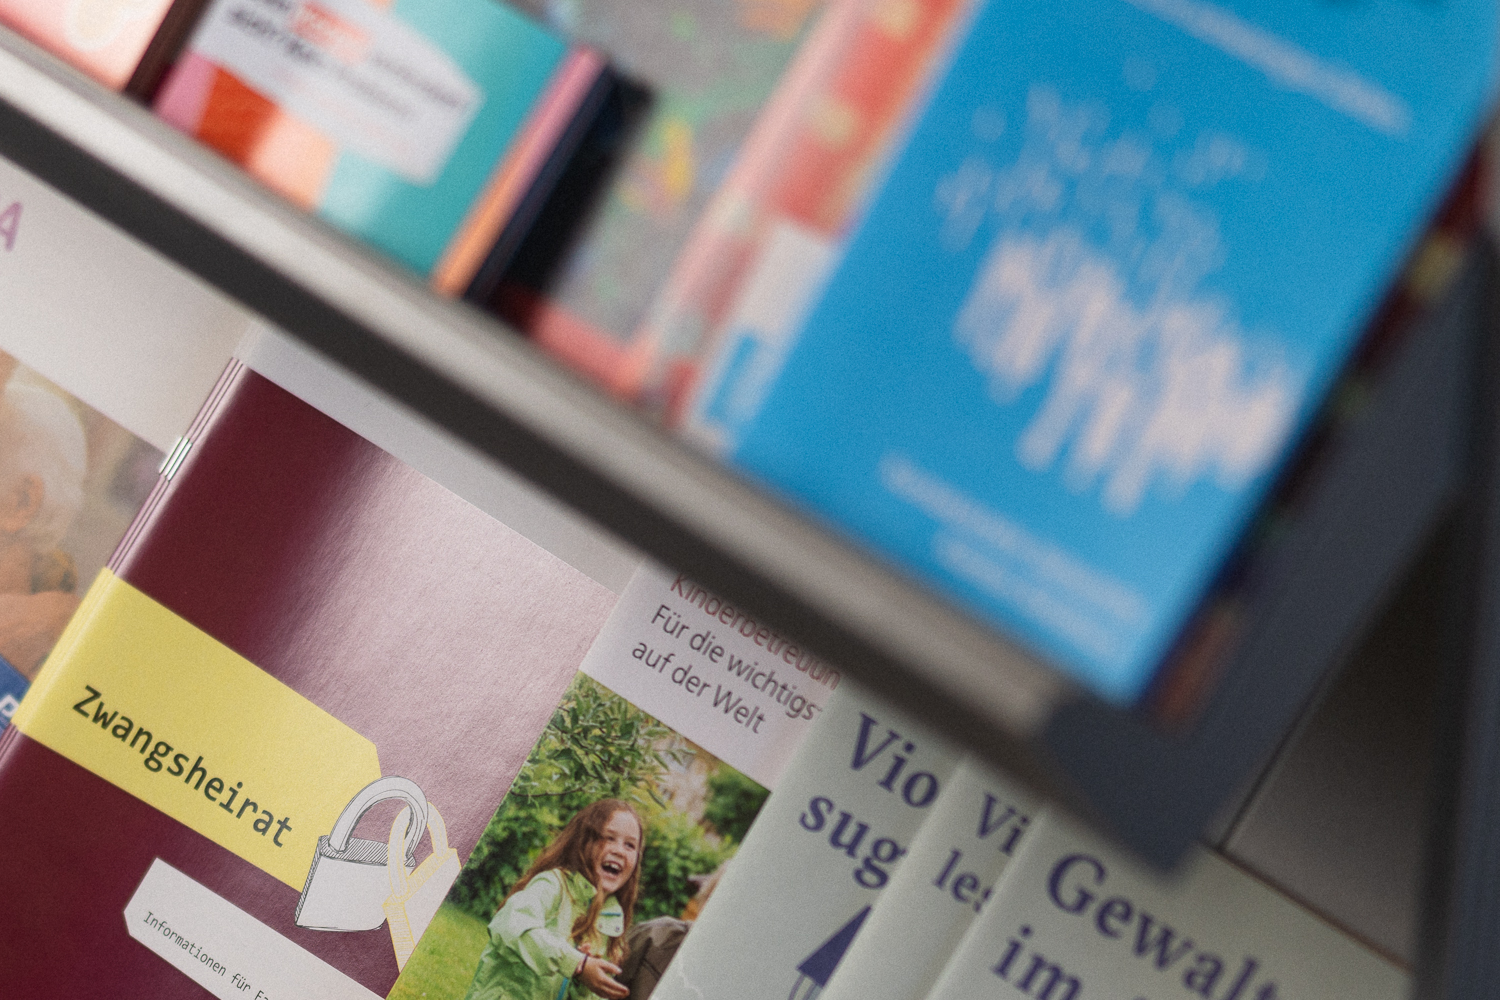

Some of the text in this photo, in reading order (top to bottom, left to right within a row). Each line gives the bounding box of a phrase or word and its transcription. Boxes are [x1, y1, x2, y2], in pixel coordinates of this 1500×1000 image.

[632, 642, 766, 734] auf der Welt
[651, 604, 820, 721] Für die wichtigs
[72, 685, 293, 848] Zwangsheirat
[851, 712, 940, 809] Vio
[799, 796, 908, 889] sug
[976, 792, 1030, 857] Vi
[143, 911, 226, 977] Informationen
[231, 972, 251, 994] für
